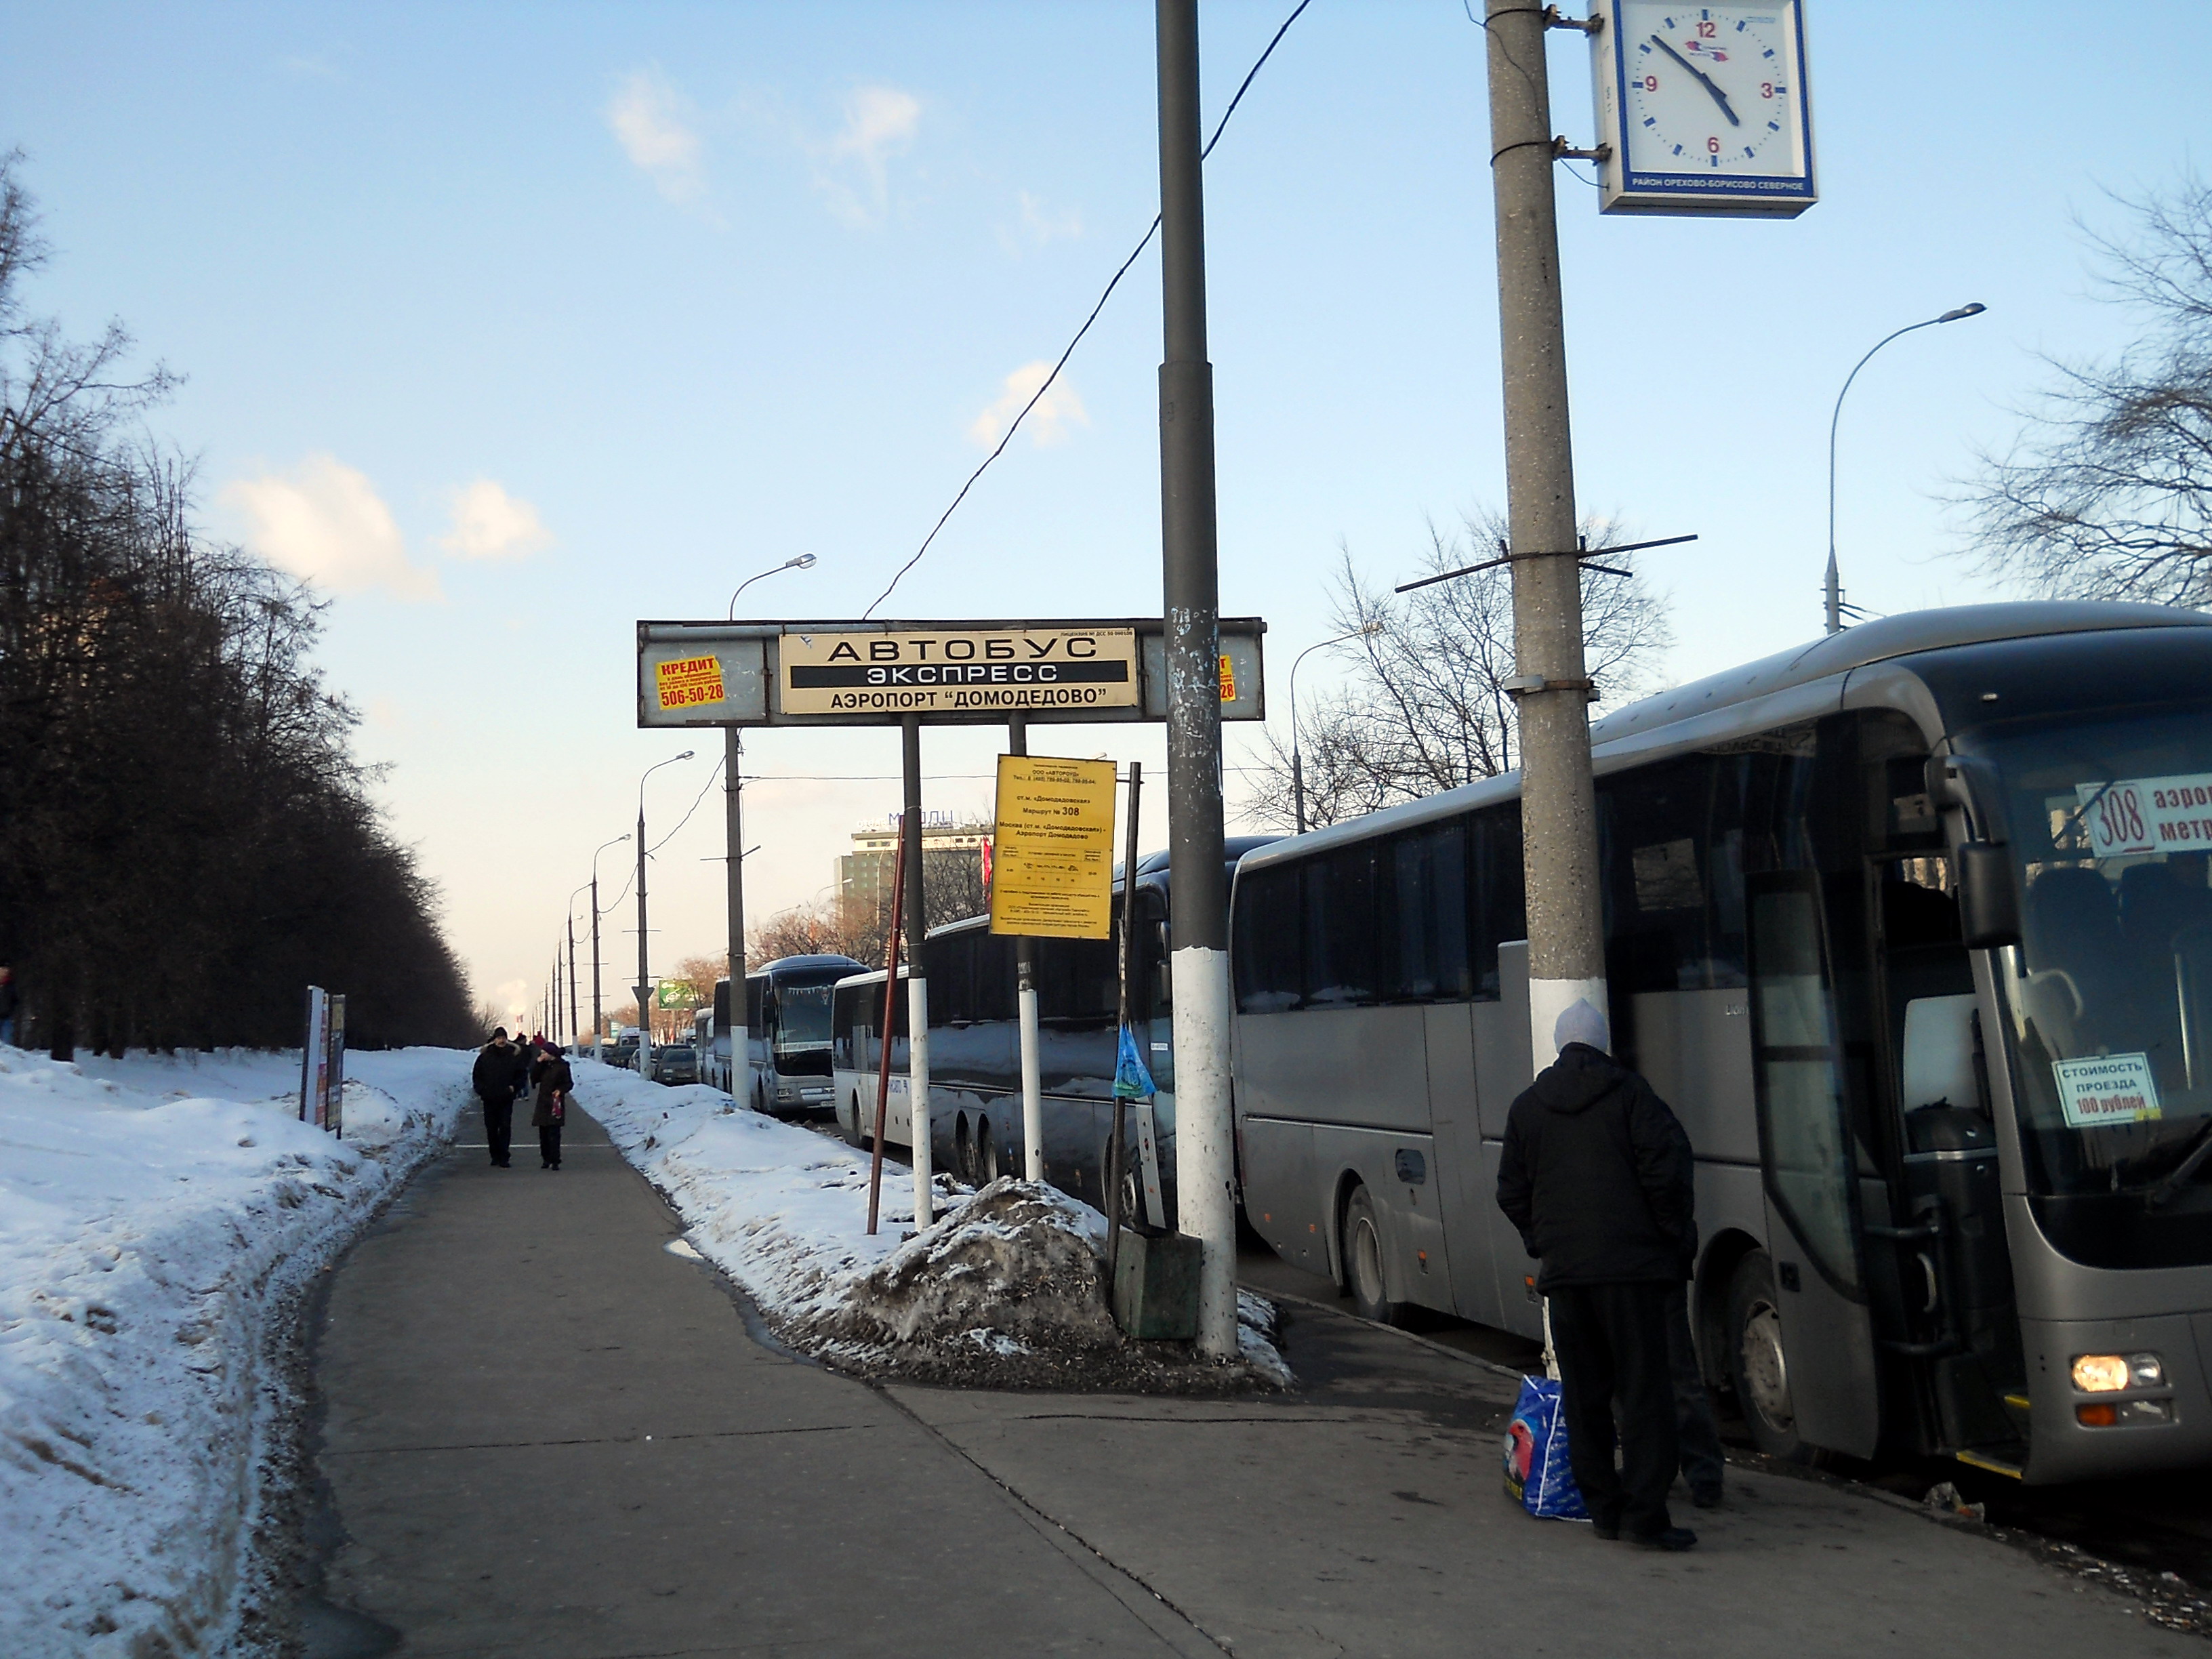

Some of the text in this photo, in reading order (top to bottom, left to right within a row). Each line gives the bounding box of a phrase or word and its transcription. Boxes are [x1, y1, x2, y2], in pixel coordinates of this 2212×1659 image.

[1696, 22, 1716, 38] 12
[1645, 76, 1658, 92] 9
[1761, 83, 1773, 99] 3
[1707, 137, 1720, 153] 6
[1632, 178, 1804, 190] РАЙОН ОРЕХОВО-БОРИСОВО СЕВЕРНОЕ
[827, 637, 1097, 662] АВТОБУС
[661, 657, 714, 676] КРЕДИТ
[867, 665, 1057, 684] ЭКСПРЕСС
[661, 683, 724, 706] 506-50-28
[831, 691, 937, 709] АЭРОПОРТ
[1022, 807, 1051, 815] Маршрут
[1062, 806, 1080, 816] 308
[2097, 789, 2145, 846] 308
[1048, 831, 1089, 840] Домодедово
[2062, 1063, 2143, 1079] СТОИМОСТЬ
[2076, 1079, 2137, 1093] ПРОЕЗДА
[2076, 1091, 2147, 1114] 100 рублей
